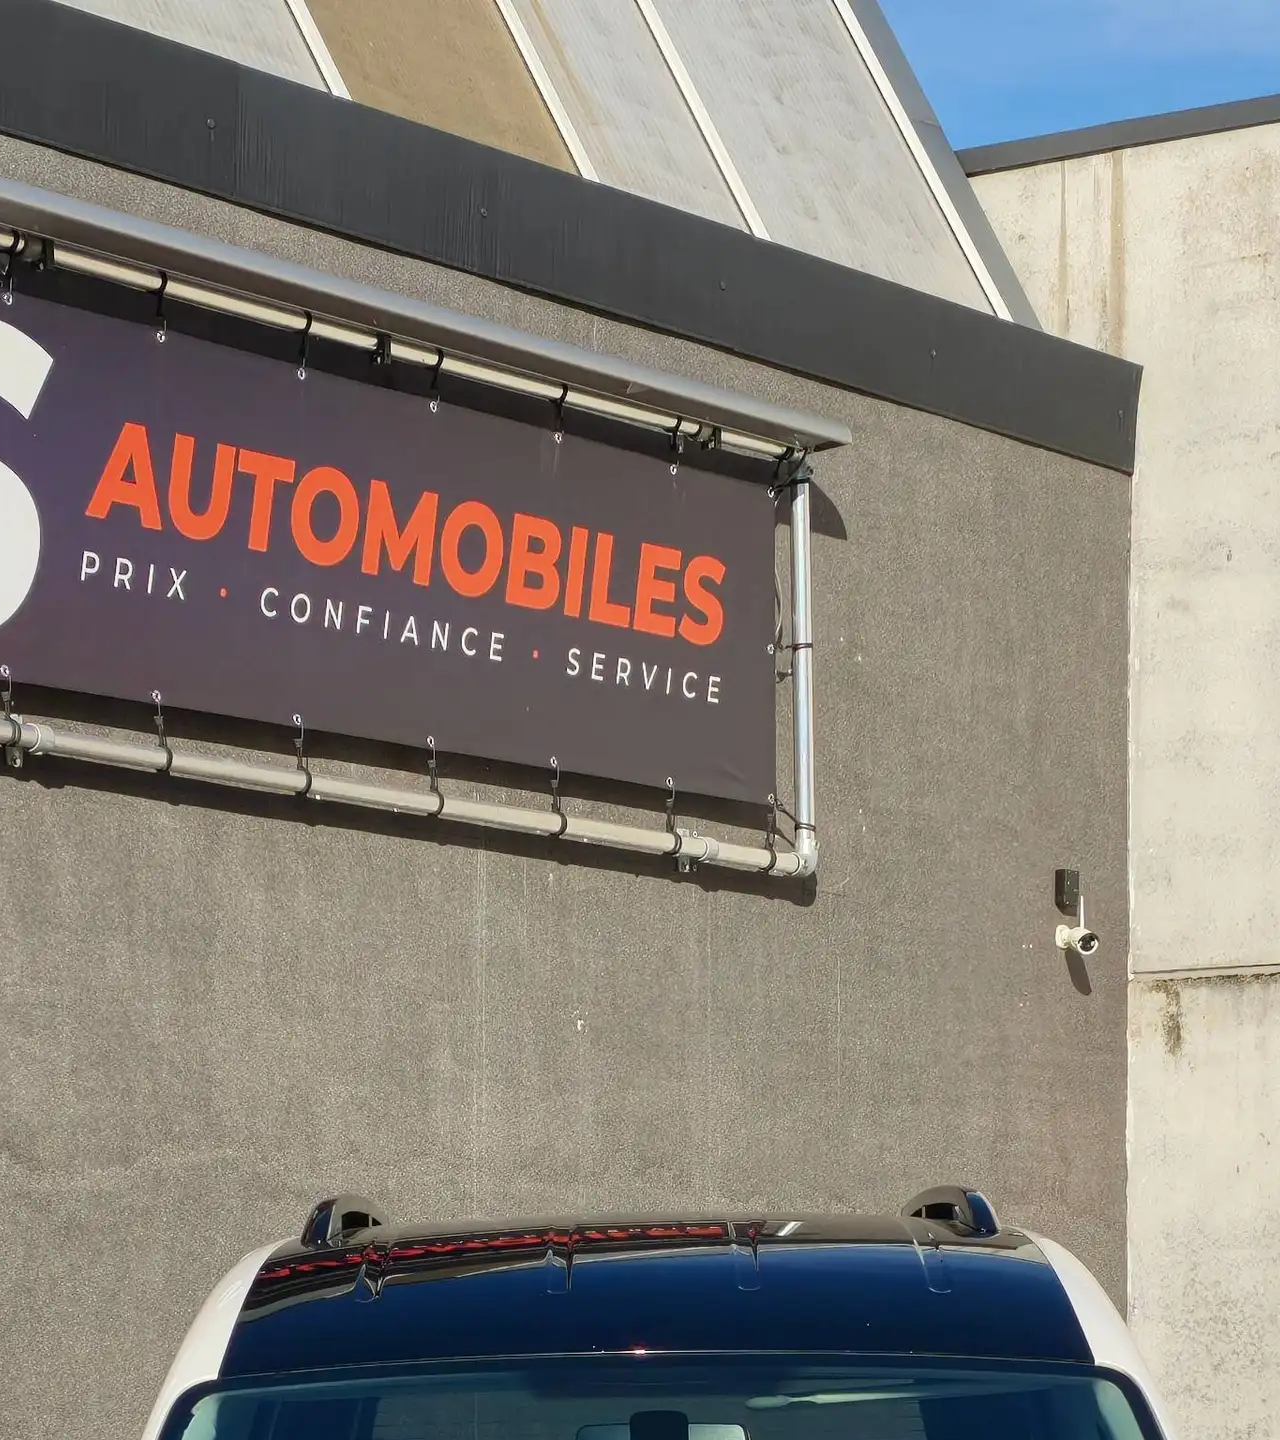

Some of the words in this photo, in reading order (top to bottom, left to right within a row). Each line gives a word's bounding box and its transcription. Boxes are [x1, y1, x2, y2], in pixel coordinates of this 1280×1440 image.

[80, 549, 190, 601] PRIX
[260, 586, 506, 662] CONFIANCE
[565, 647, 723, 704] SERVICE
[85, 421, 726, 646] AUTOMOBILES
